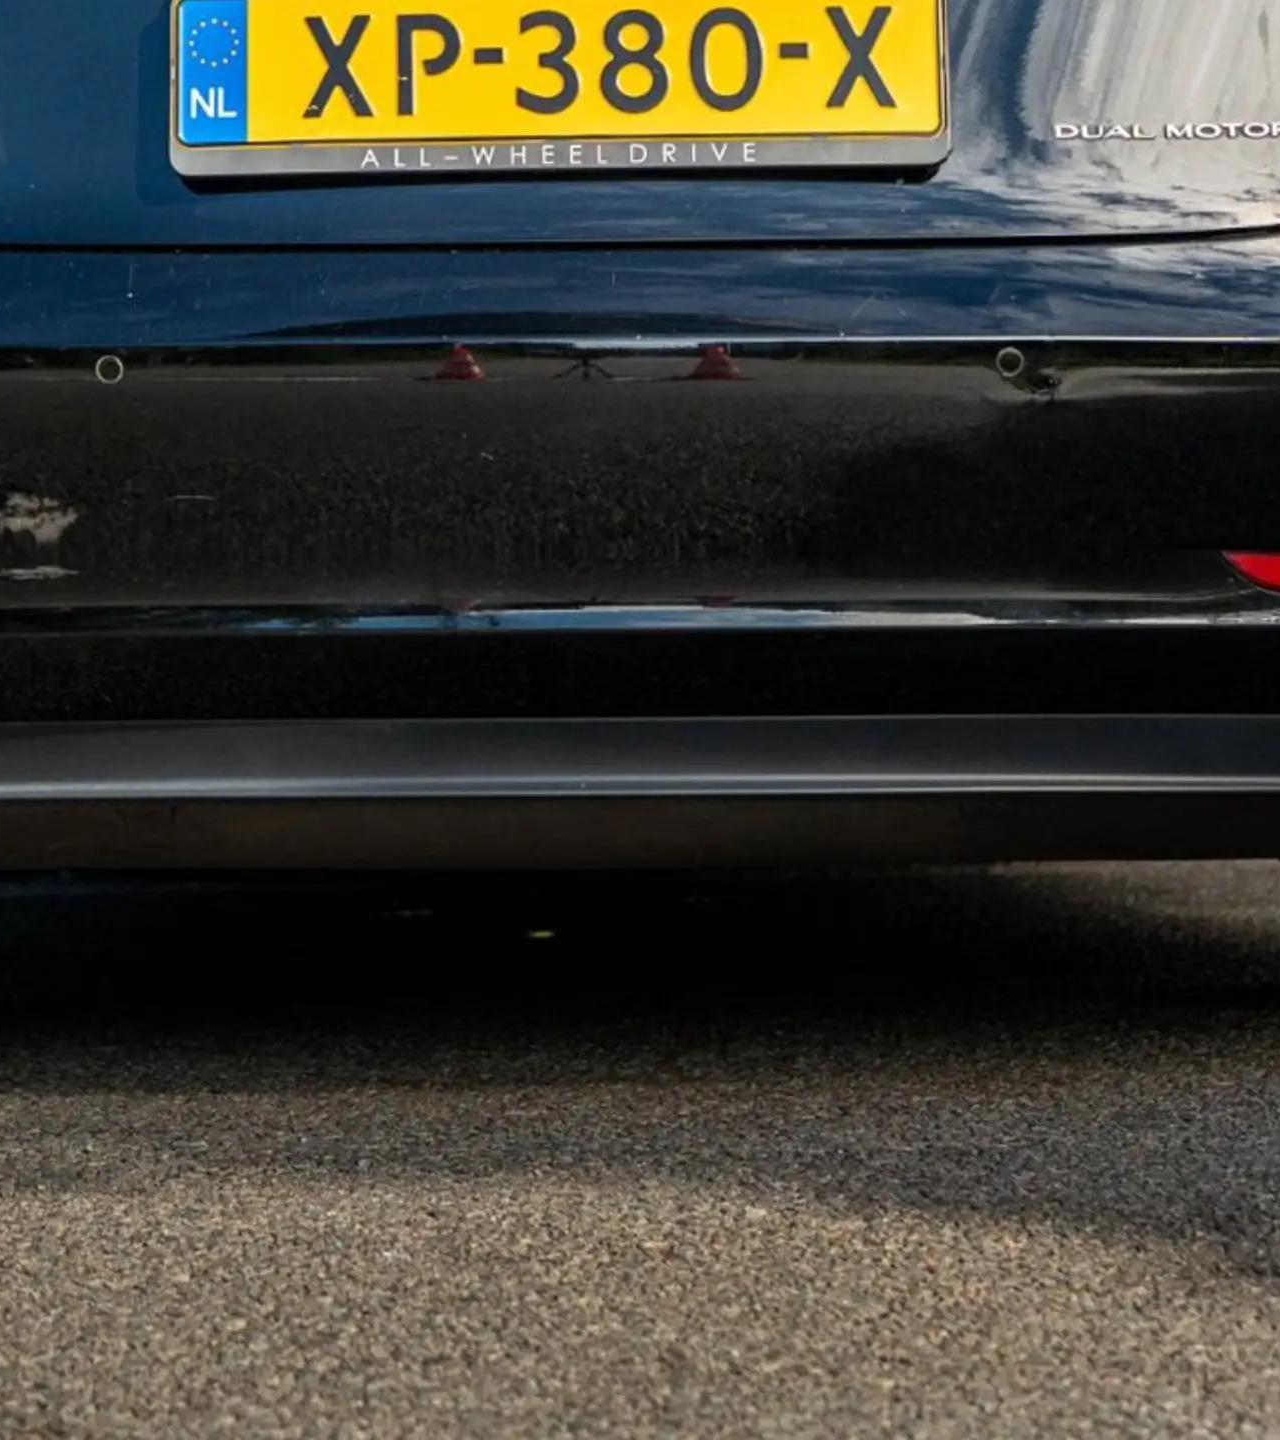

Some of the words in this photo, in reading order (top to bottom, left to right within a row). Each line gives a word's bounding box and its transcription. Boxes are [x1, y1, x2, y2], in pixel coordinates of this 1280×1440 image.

[302, 6, 898, 118] XP-380-X
[189, 87, 237, 119] NL
[1054, 122, 1157, 140] DUAL
